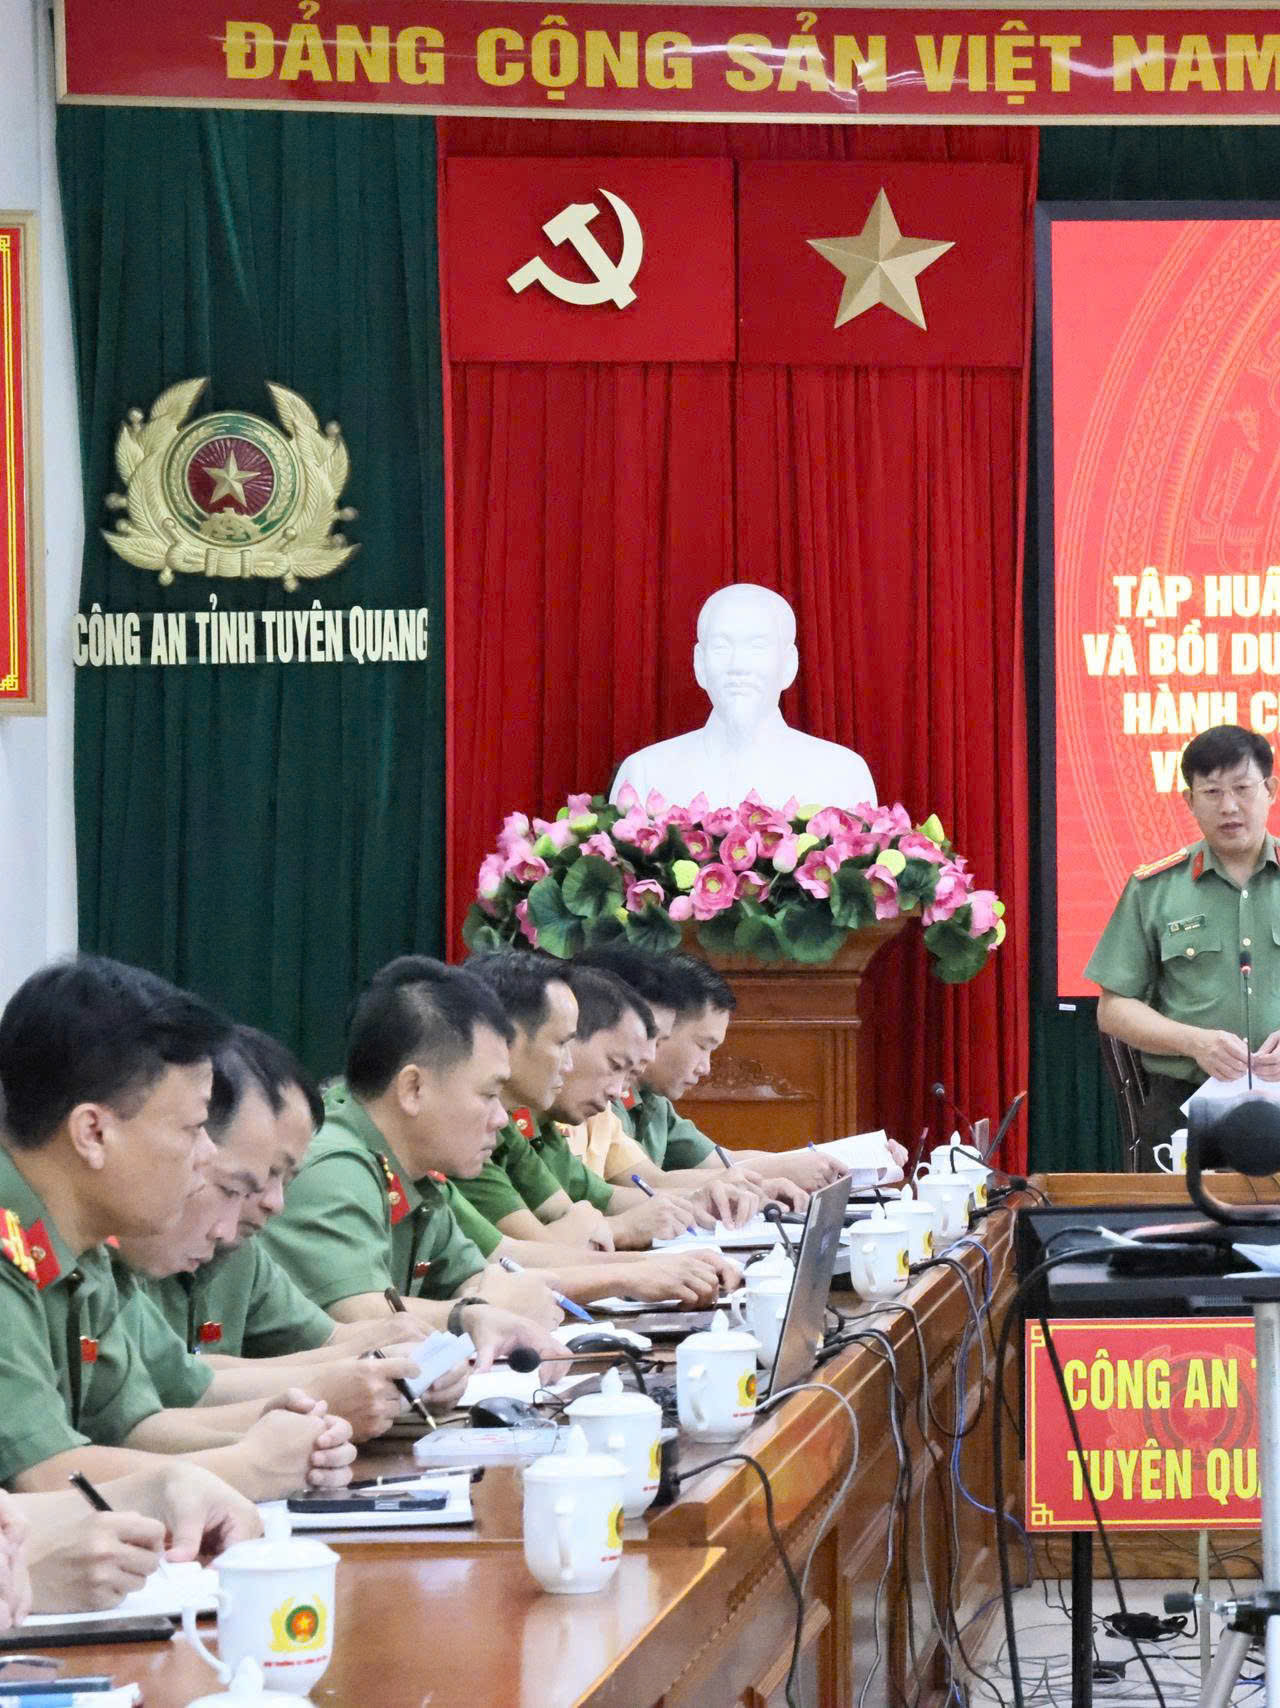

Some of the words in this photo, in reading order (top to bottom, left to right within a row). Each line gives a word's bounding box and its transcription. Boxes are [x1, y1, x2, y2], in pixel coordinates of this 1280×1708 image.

[223, 1, 445, 86] ĐẢNG
[477, 16, 693, 101] CỘNG
[726, 12, 887, 92] SẢN
[915, 20, 1082, 105] VIỆT
[1112, 566, 1193, 628] TẬP
[73, 602, 141, 667] CÔNG
[150, 612, 188, 665] AN
[194, 592, 256, 665] TỈNH
[261, 599, 344, 664] TUYÊN
[348, 605, 429, 665] QUANG
[1082, 624, 1139, 677] VÀ
[1148, 618, 1219, 676] BỒI
[1123, 682, 1238, 735] HÀNH
[1063, 1348, 1171, 1411] CÔNG
[1184, 1359, 1239, 1409] AN
[1066, 1438, 1193, 1502] TUYÊN
